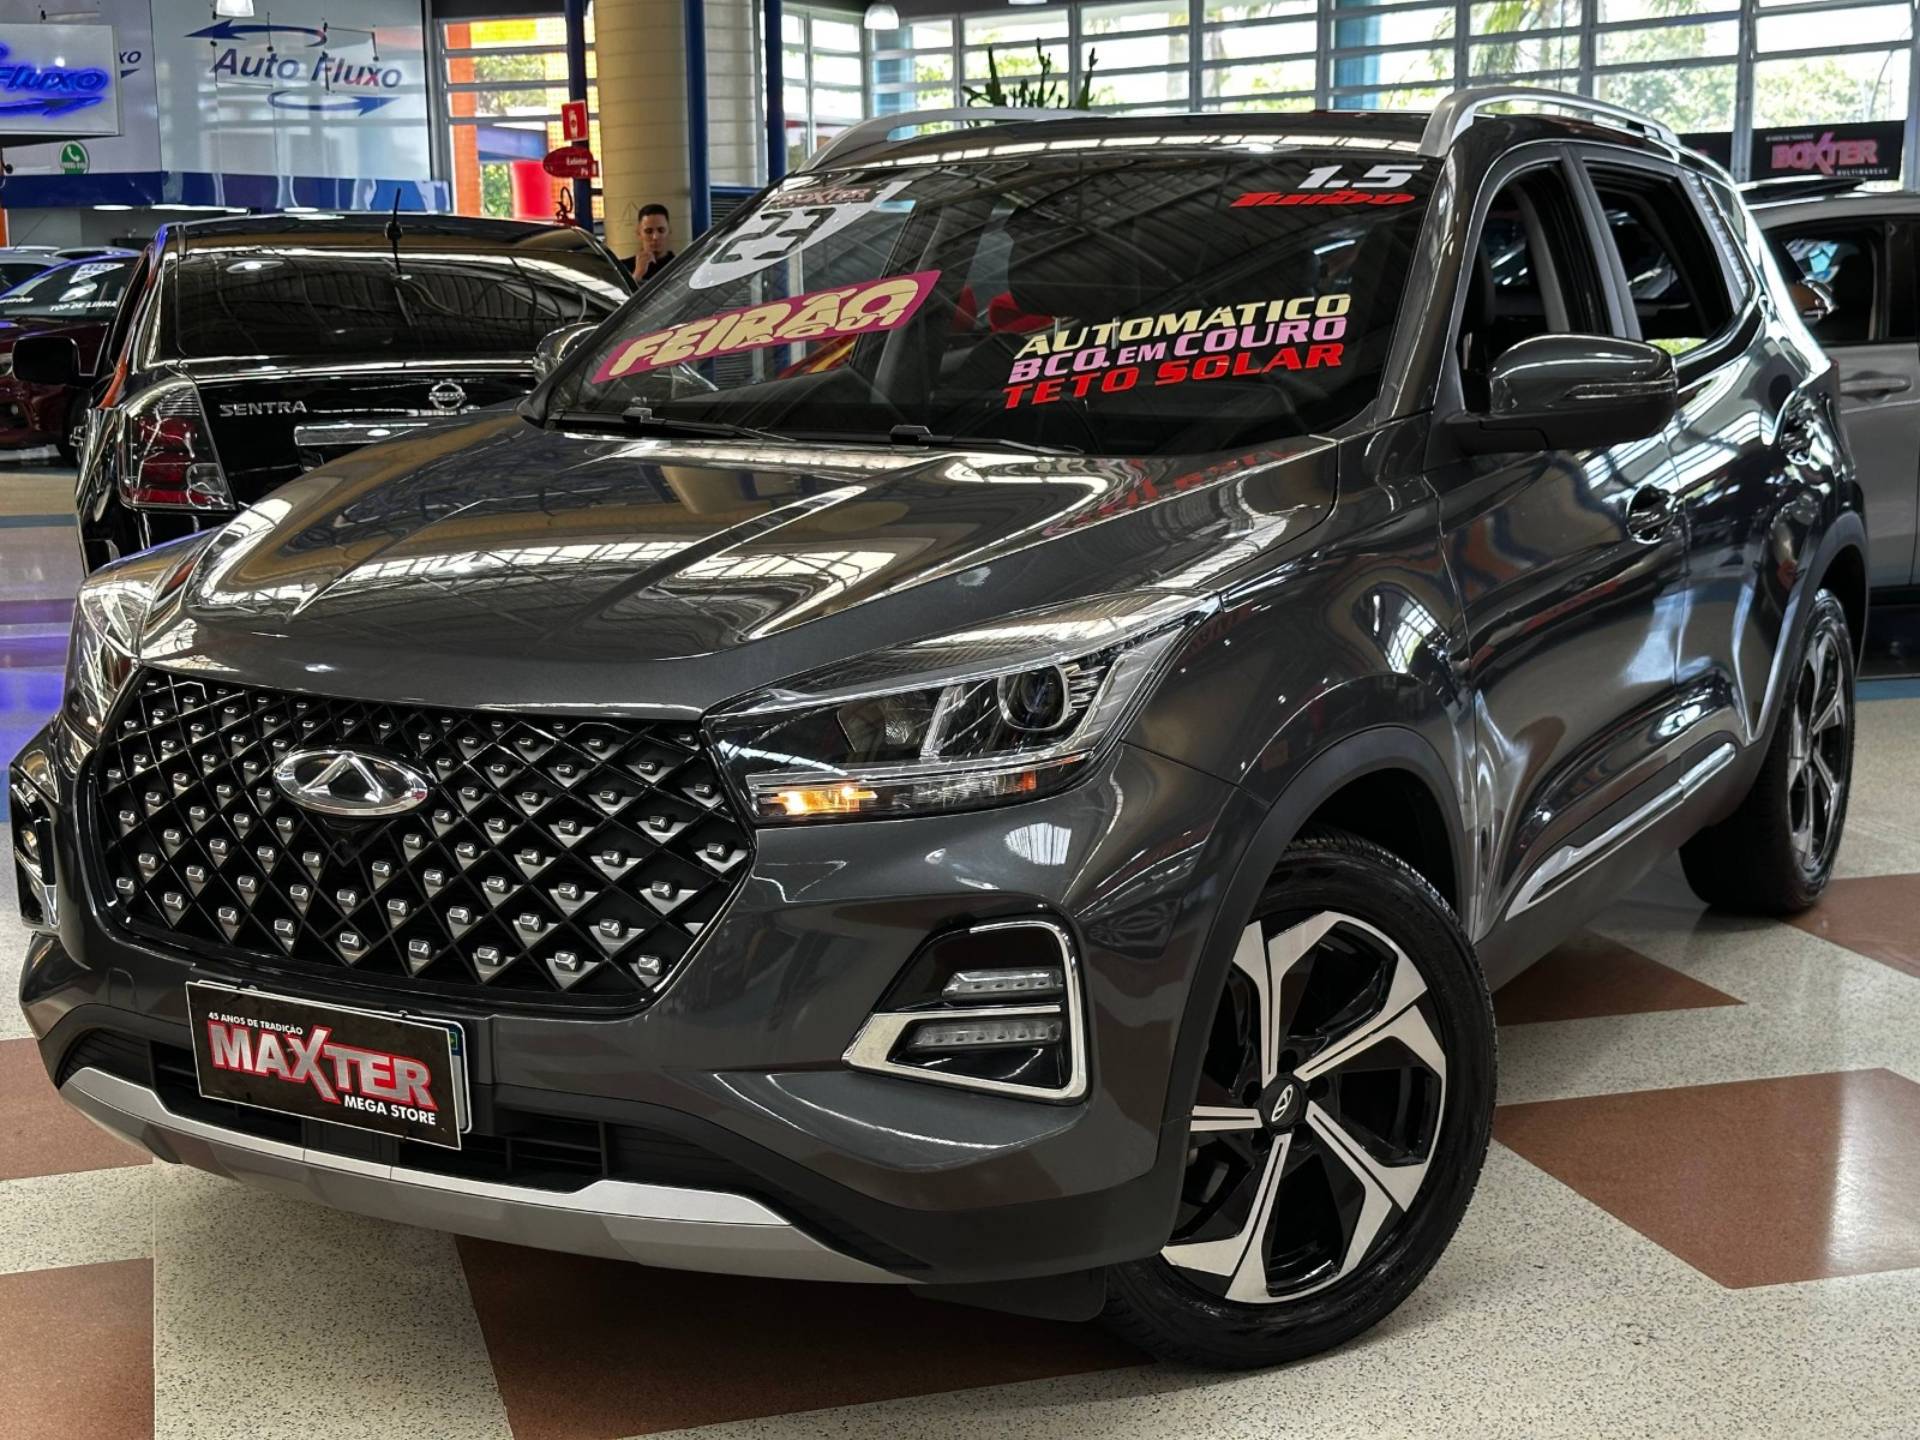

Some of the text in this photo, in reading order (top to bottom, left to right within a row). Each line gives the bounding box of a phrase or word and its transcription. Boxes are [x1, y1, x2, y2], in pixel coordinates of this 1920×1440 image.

[210, 48, 402, 88] Auto Fluxo
[1771, 131, 1878, 175] BOXTER
[1297, 164, 1424, 189] 1.5
[1229, 188, 1415, 208] Turbo
[710, 207, 837, 264] 23
[1116, 342, 1167, 366] EM
[1173, 316, 1347, 357] COURO
[1001, 343, 1345, 410] TETO SOLAR
[219, 400, 308, 417] SENTRA
[221, 1013, 246, 1025] ANOS
[247, 1018, 259, 1028] DE
[208, 1020, 438, 1111] MAXTER
[344, 1095, 436, 1126] MEGA STORE
